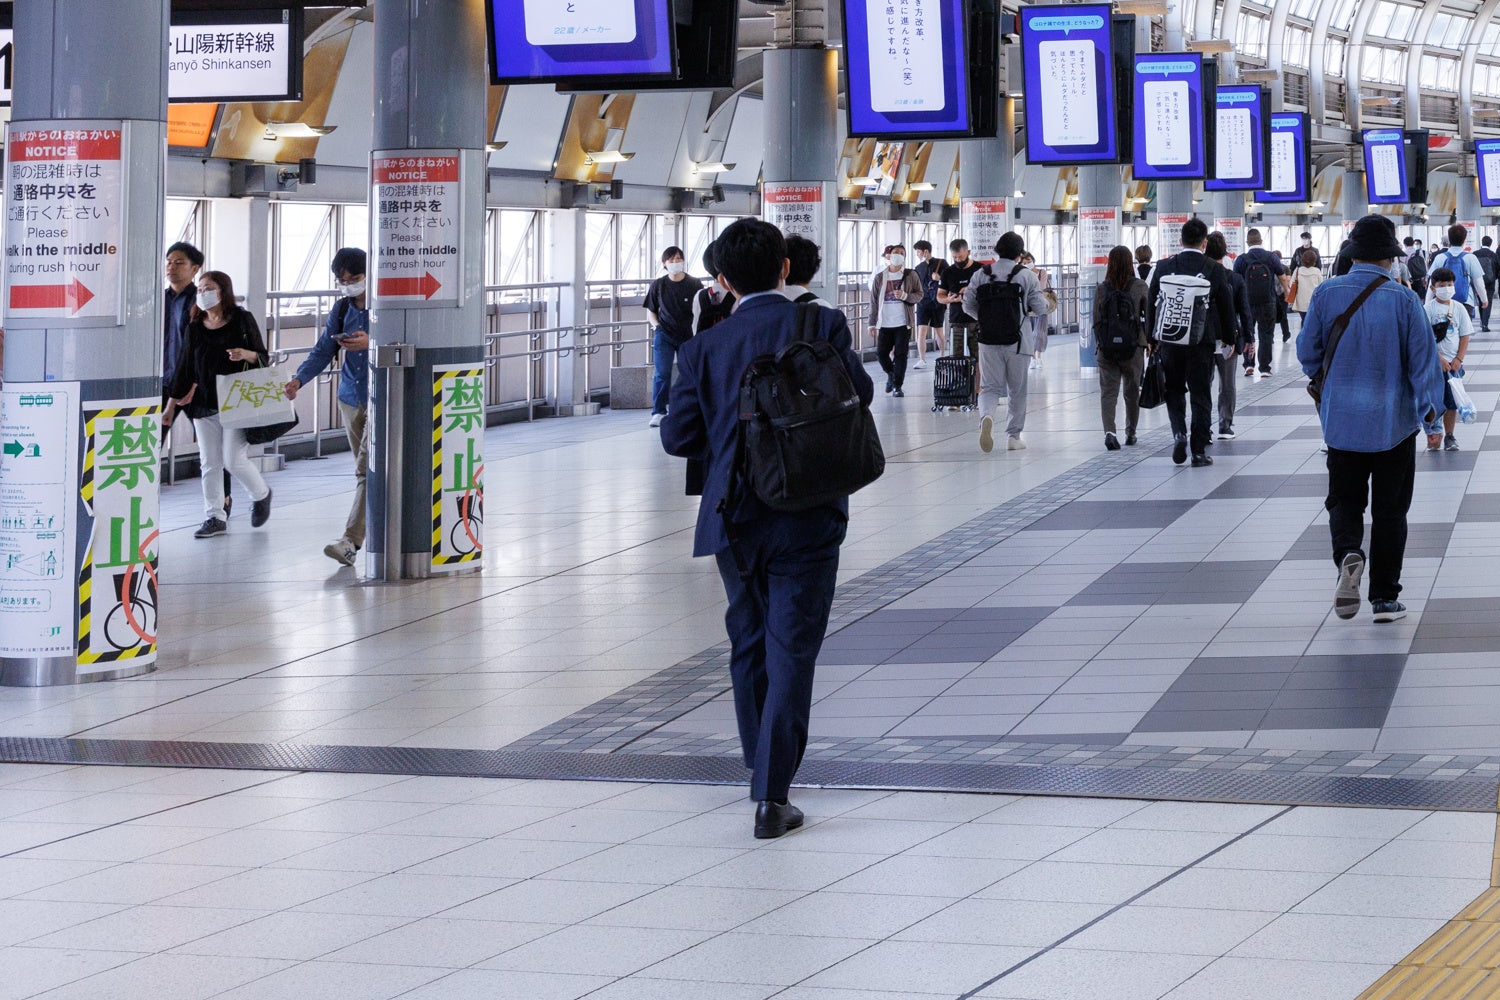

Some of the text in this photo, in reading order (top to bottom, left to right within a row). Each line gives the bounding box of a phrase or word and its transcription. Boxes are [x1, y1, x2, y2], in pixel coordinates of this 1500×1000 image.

[170, 58, 271, 73] anyō Shinkansen
[25, 146, 77, 157] NOTICE
[12, 164, 102, 179] 朝の混雑時は
[388, 171, 427, 180] NOTICE
[13, 183, 96, 200] 通路中央を
[9, 205, 110, 221] ご通行ください
[379, 217, 451, 230] 通行ください
[27, 228, 68, 238] Please
[391, 234, 422, 242] Please
[6, 243, 117, 256] alk in the middle
[387, 246, 395, 256] in
[397, 246, 415, 256] the
[418, 245, 457, 255] middle
[38, 261, 64, 273] rush
[69, 261, 100, 272] hour
[400, 260, 419, 269] rush
[423, 259, 446, 268] hour
[1164, 297, 1174, 323] FACE
[1172, 288, 1185, 325] NORTH
[1181, 305, 1191, 326] THE
[444, 377, 483, 493] 禁止
[95, 416, 157, 569] 禁止
